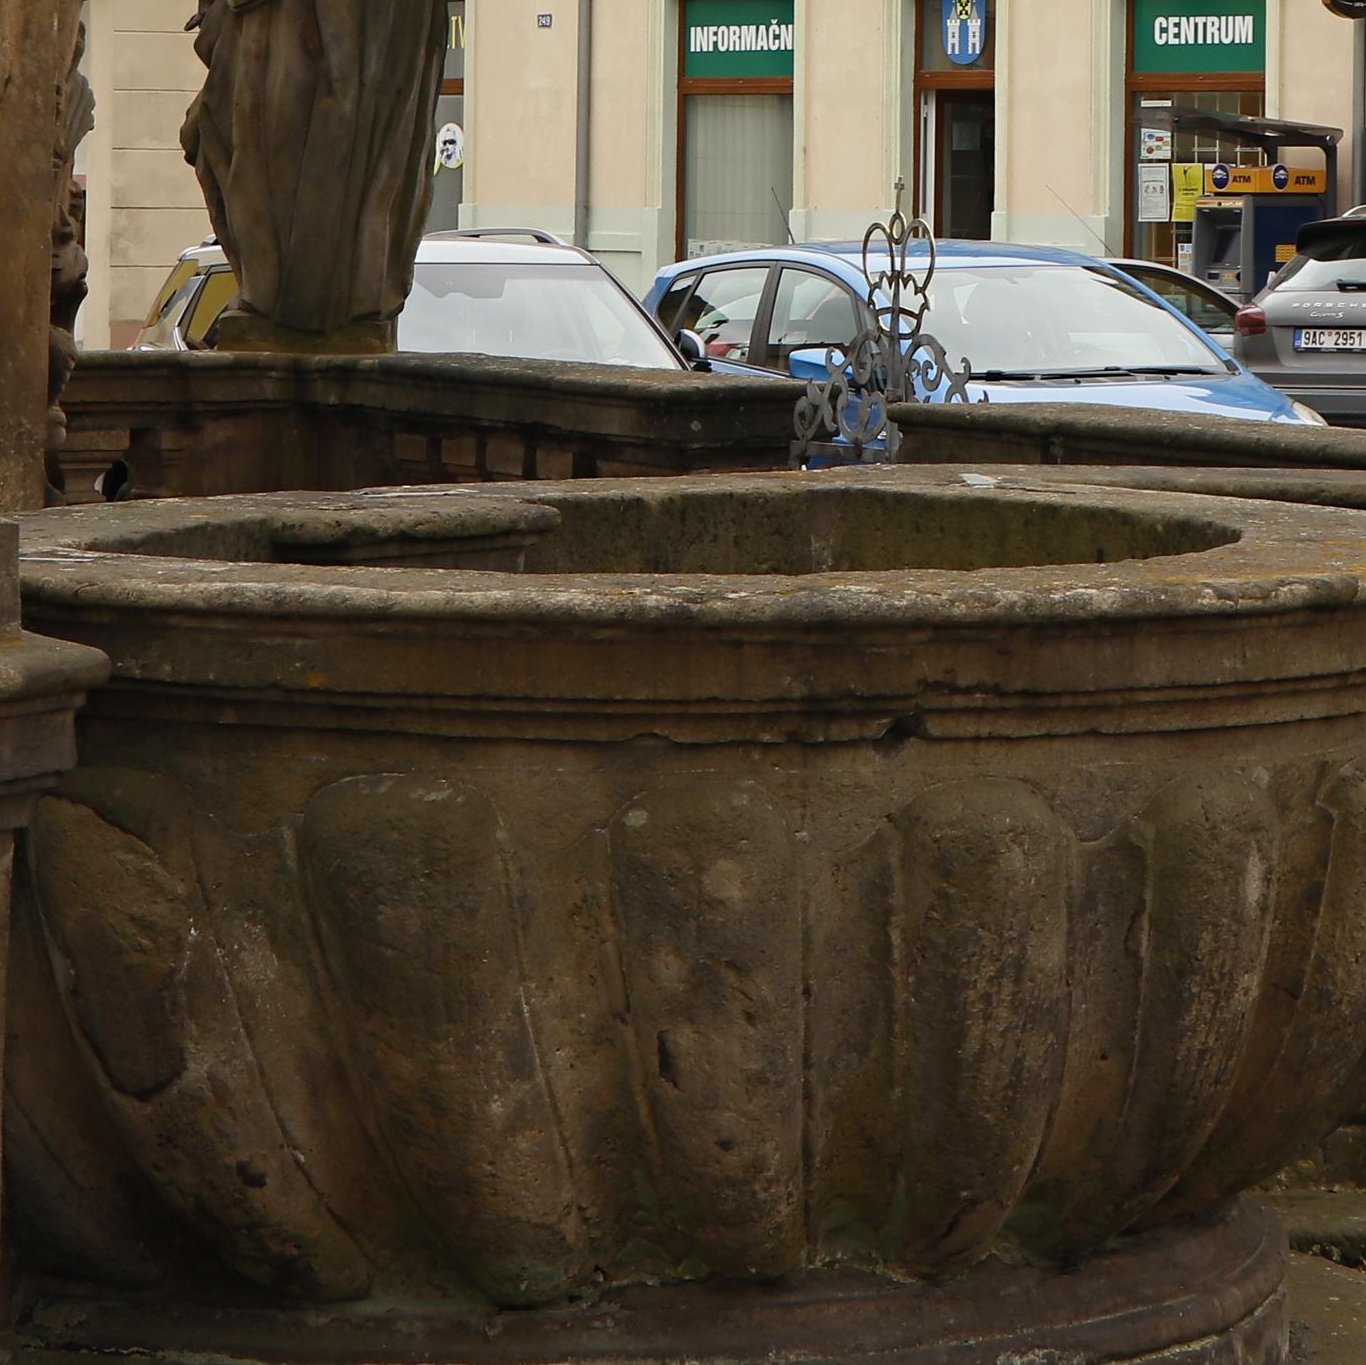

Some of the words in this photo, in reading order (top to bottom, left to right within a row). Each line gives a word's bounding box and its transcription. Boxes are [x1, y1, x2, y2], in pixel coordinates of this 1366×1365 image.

[690, 19, 794, 52] INFORMAČN
[1154, 16, 1254, 45] CENTRUM
[1232, 175, 1251, 184] ATM
[1295, 175, 1316, 185] ATM
[1303, 330, 1325, 346] 9AC
[1334, 330, 1364, 347] 2951
